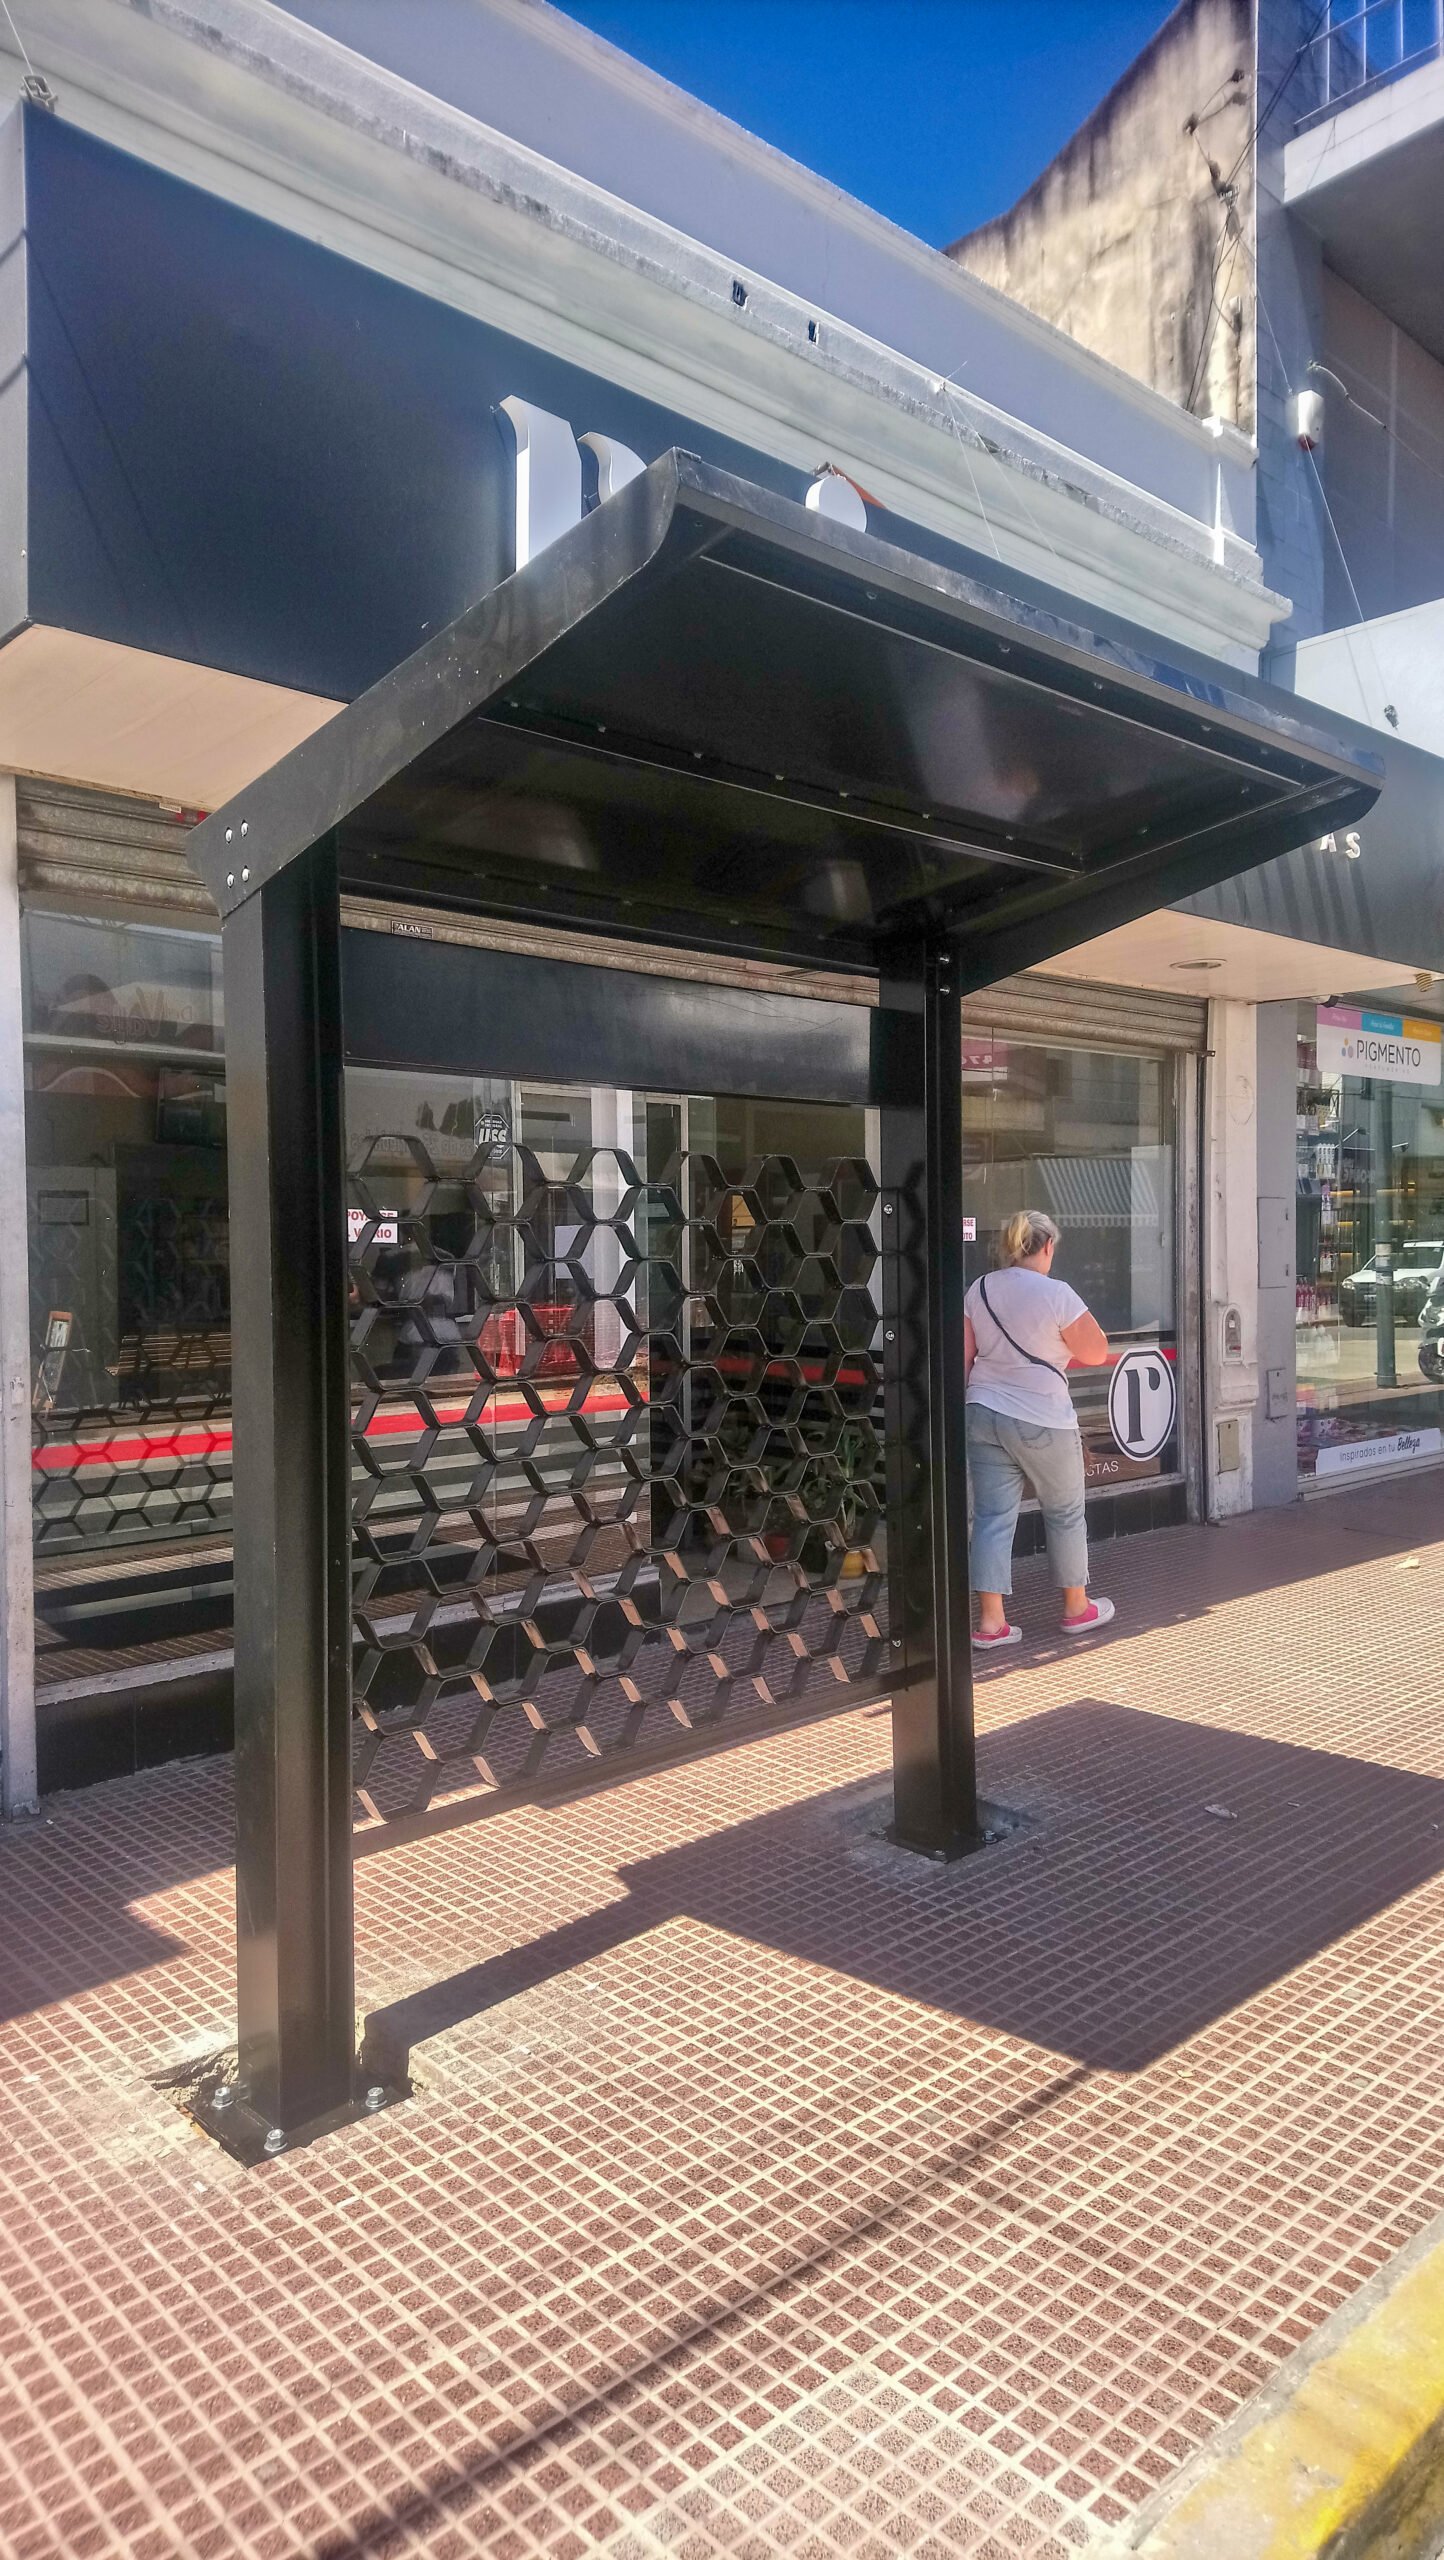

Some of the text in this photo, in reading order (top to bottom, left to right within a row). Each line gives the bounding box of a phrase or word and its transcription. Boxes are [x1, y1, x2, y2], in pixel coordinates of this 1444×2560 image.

[1356, 1039, 1422, 1068] PIGMENTO
[1378, 1445, 1387, 1455] en
[1388, 1443, 1396, 1453] tu
